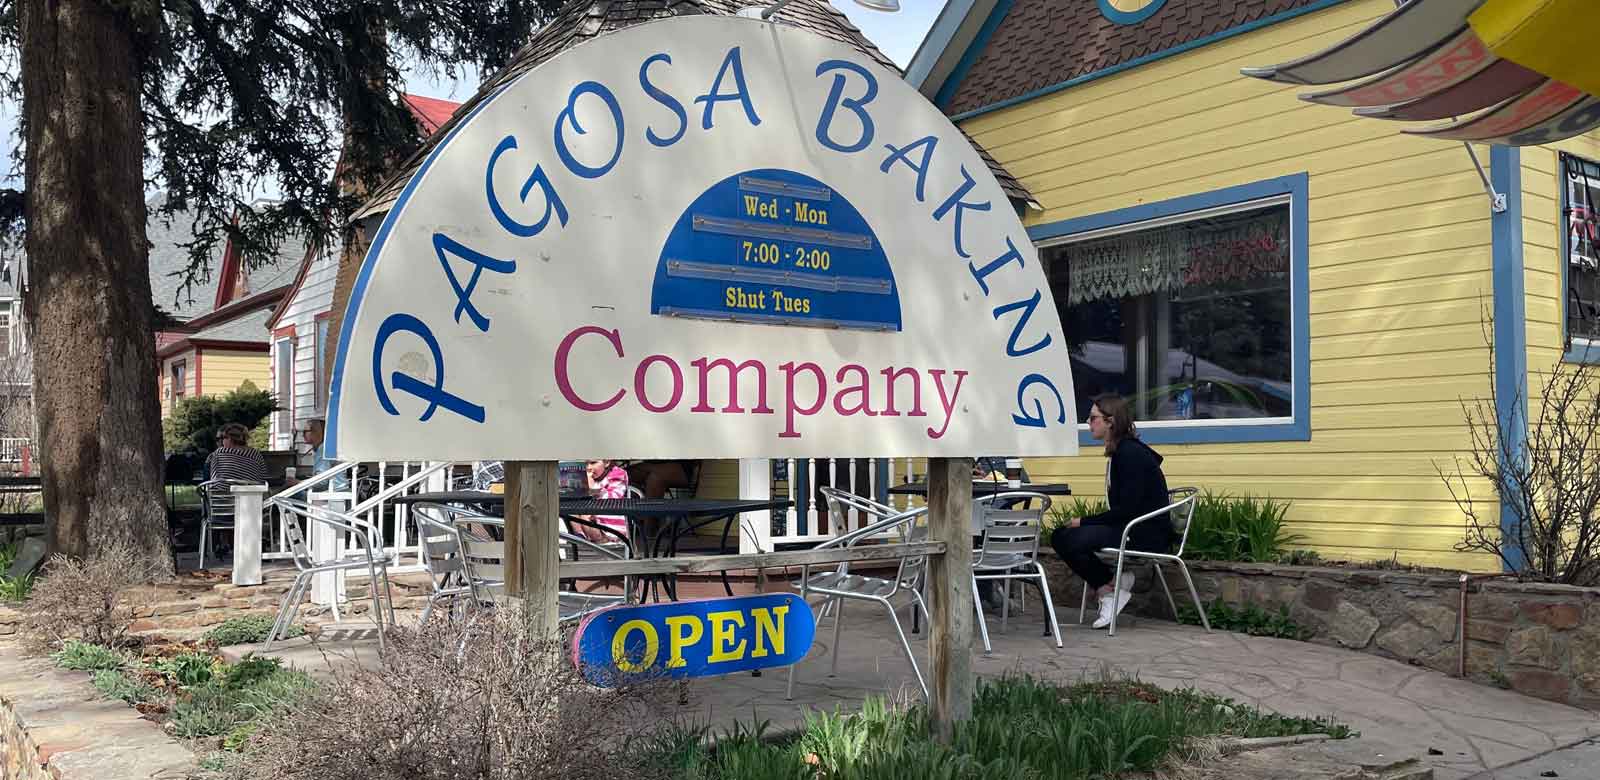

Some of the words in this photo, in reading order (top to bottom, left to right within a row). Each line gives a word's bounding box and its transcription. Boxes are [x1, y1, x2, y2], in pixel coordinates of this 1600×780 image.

[744, 196, 778, 219] Wed
[795, 202, 828, 225] Mon
[372, 46, 762, 424] PAGOSA
[815, 59, 1066, 428] BAKING
[742, 241, 780, 265] 7:00
[795, 247, 831, 271] 2:00
[726, 286, 766, 310] Shut
[771, 290, 811, 314] Tues
[553, 325, 970, 440] Company
[611, 605, 789, 673] OPEN
